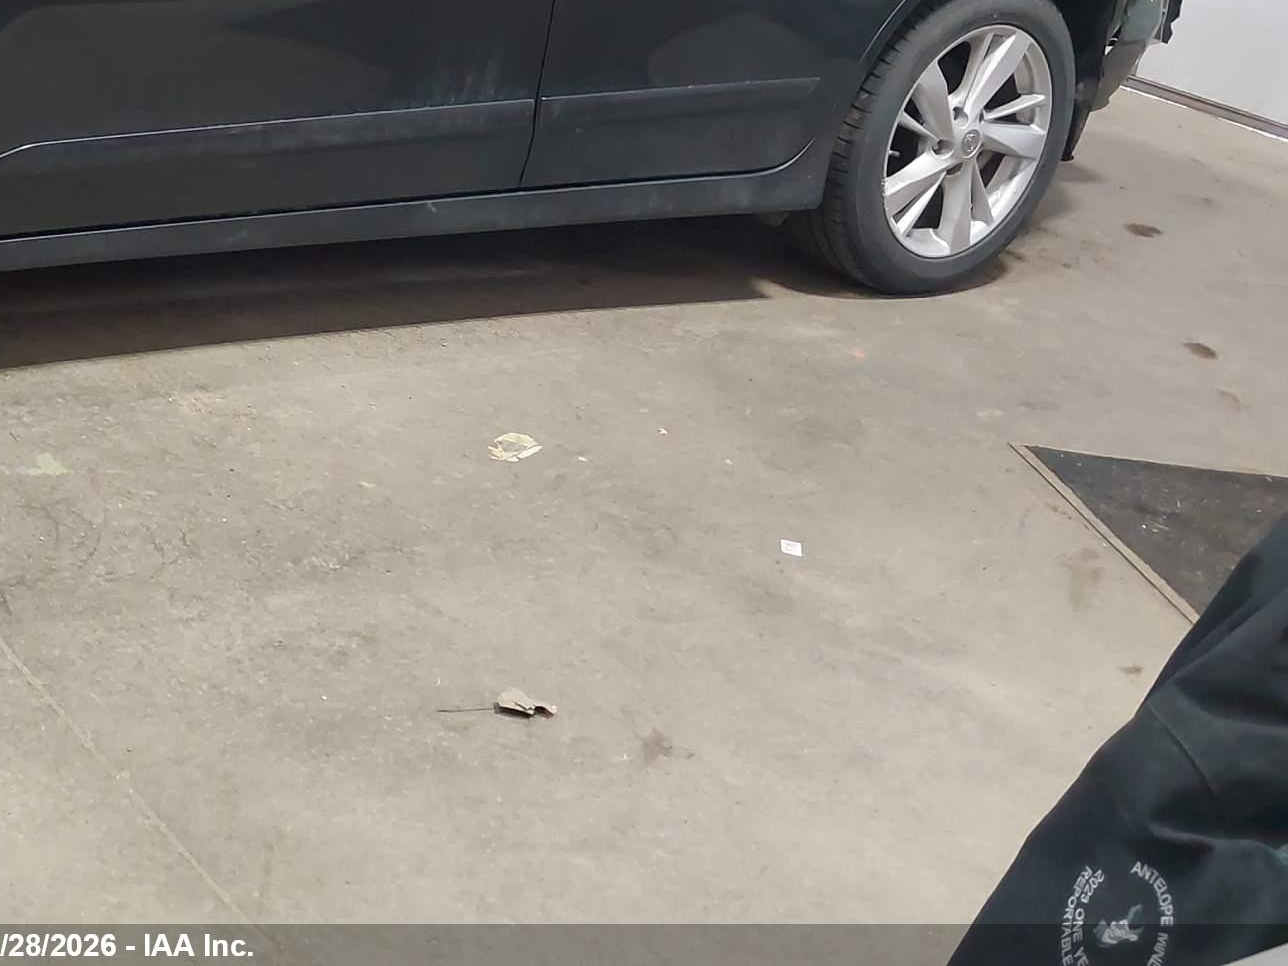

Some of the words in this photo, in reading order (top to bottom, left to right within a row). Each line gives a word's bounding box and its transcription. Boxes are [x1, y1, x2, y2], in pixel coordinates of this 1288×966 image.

[1060, 865, 1093, 966] REPORTABLE
[1072, 907, 1086, 943] ONE
[1130, 860, 1174, 928] ANTELOPE
